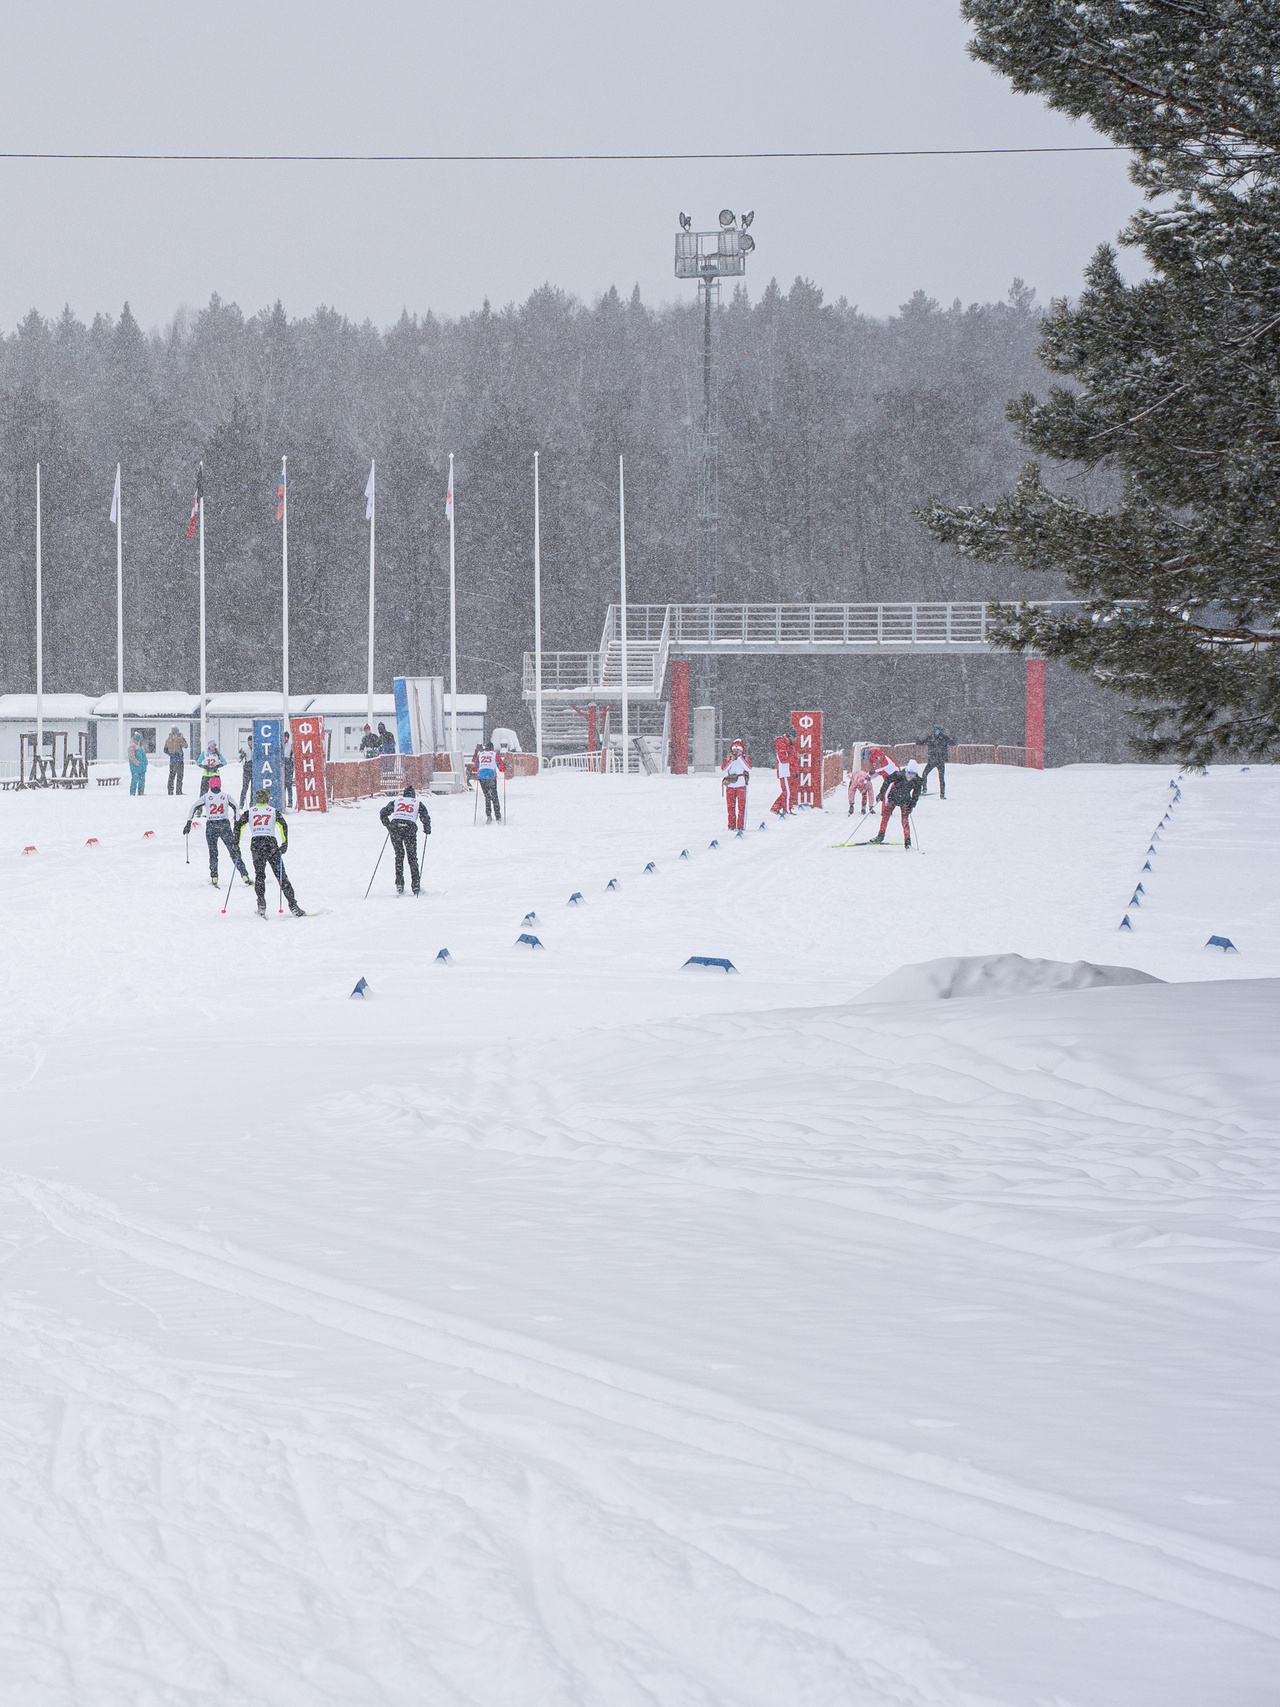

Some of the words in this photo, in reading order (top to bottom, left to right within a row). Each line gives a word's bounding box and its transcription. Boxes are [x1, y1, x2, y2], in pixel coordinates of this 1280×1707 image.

[207, 758, 216, 767] 12
[261, 725, 273, 800] СТАР
[480, 755, 493, 764] 25
[798, 715, 814, 806] ФИНИШ
[299, 722, 320, 810] ФИНИШ
[209, 803, 225, 815] 24
[396, 802, 415, 814] 26
[253, 814, 272, 827] 27
